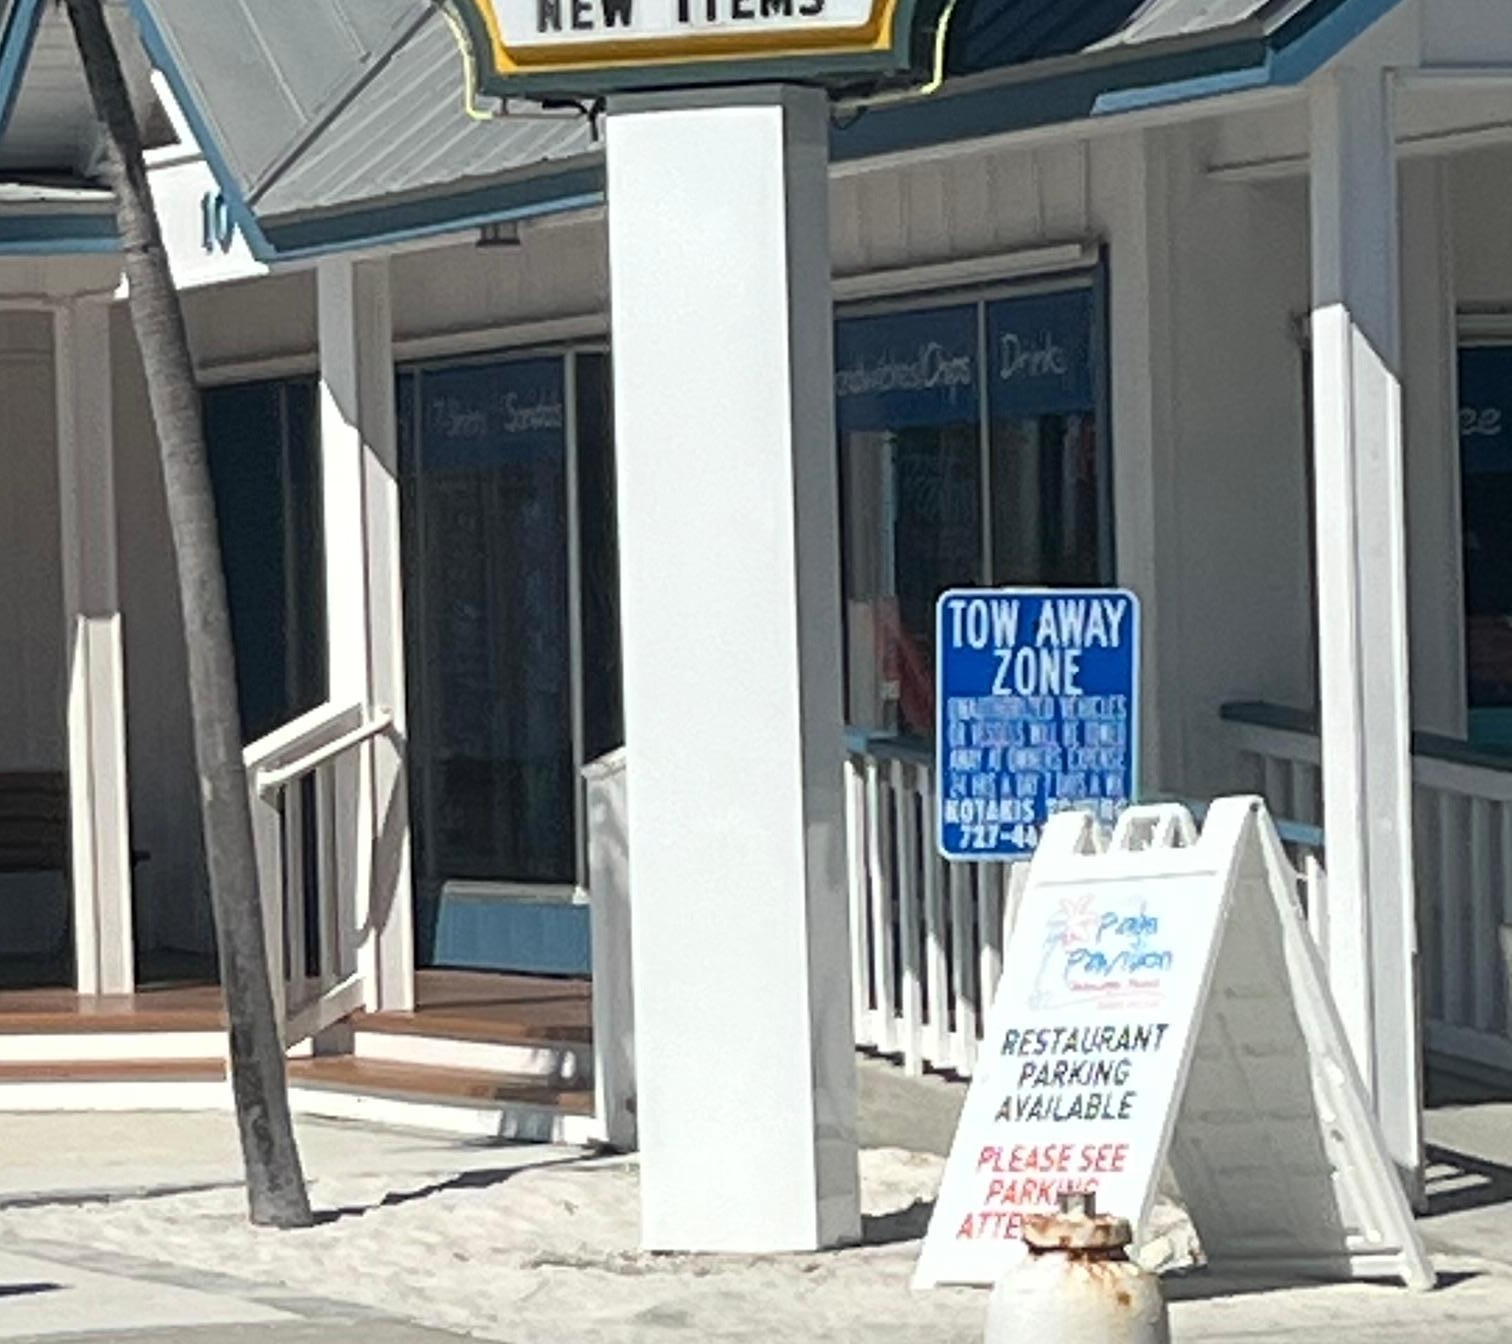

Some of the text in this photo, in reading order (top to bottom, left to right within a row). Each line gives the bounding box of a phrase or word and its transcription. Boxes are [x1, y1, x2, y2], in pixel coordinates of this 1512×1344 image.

[947, 598, 1127, 649] TOW AWAY
[991, 646, 1084, 696] ZONE
[1001, 1024, 1170, 1057] RESTAURANT
[1018, 1057, 1133, 1089] PARKING
[995, 1091, 1137, 1123] AVAILABLE
[977, 1144, 1129, 1173] PLEASE SEE
